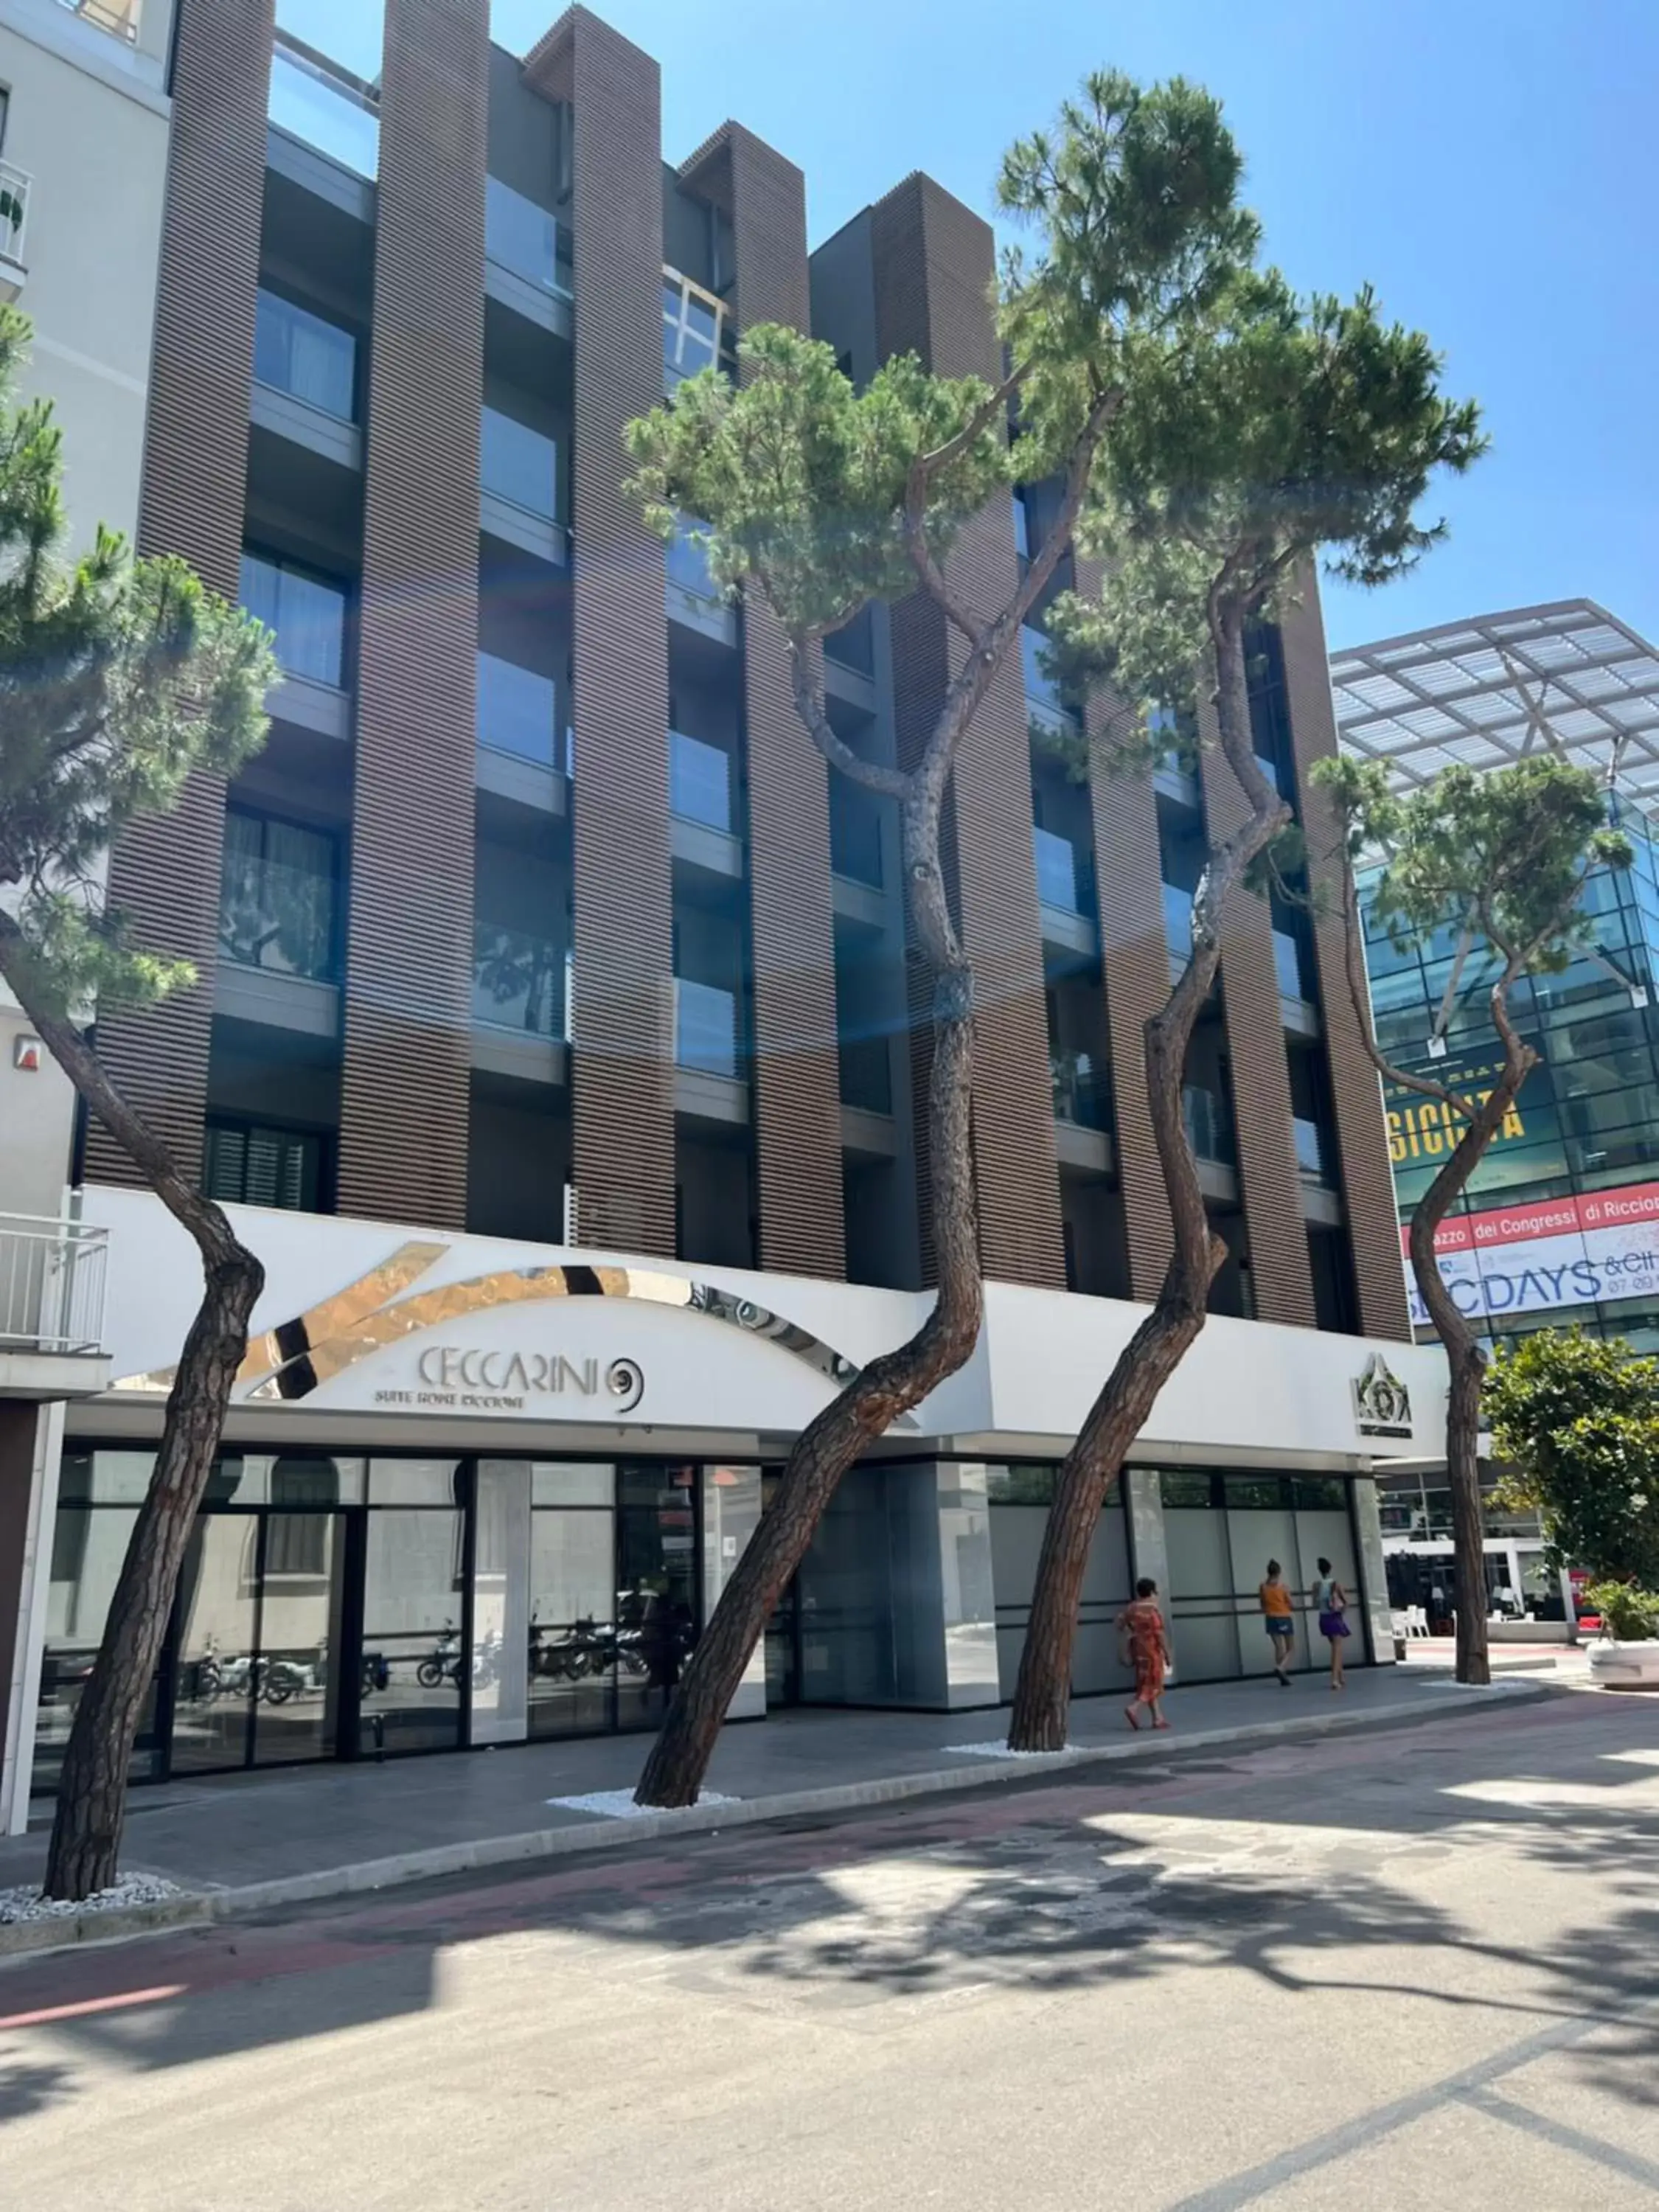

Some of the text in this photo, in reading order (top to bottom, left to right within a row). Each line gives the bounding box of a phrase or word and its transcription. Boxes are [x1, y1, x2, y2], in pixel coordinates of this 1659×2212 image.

[1475, 1223, 1498, 1239] dei
[1500, 1208, 1576, 1234] Congressi
[1585, 1203, 1601, 1220] di
[418, 1346, 598, 1395] CECCARINI
[375, 1390, 413, 1404] SUITE
